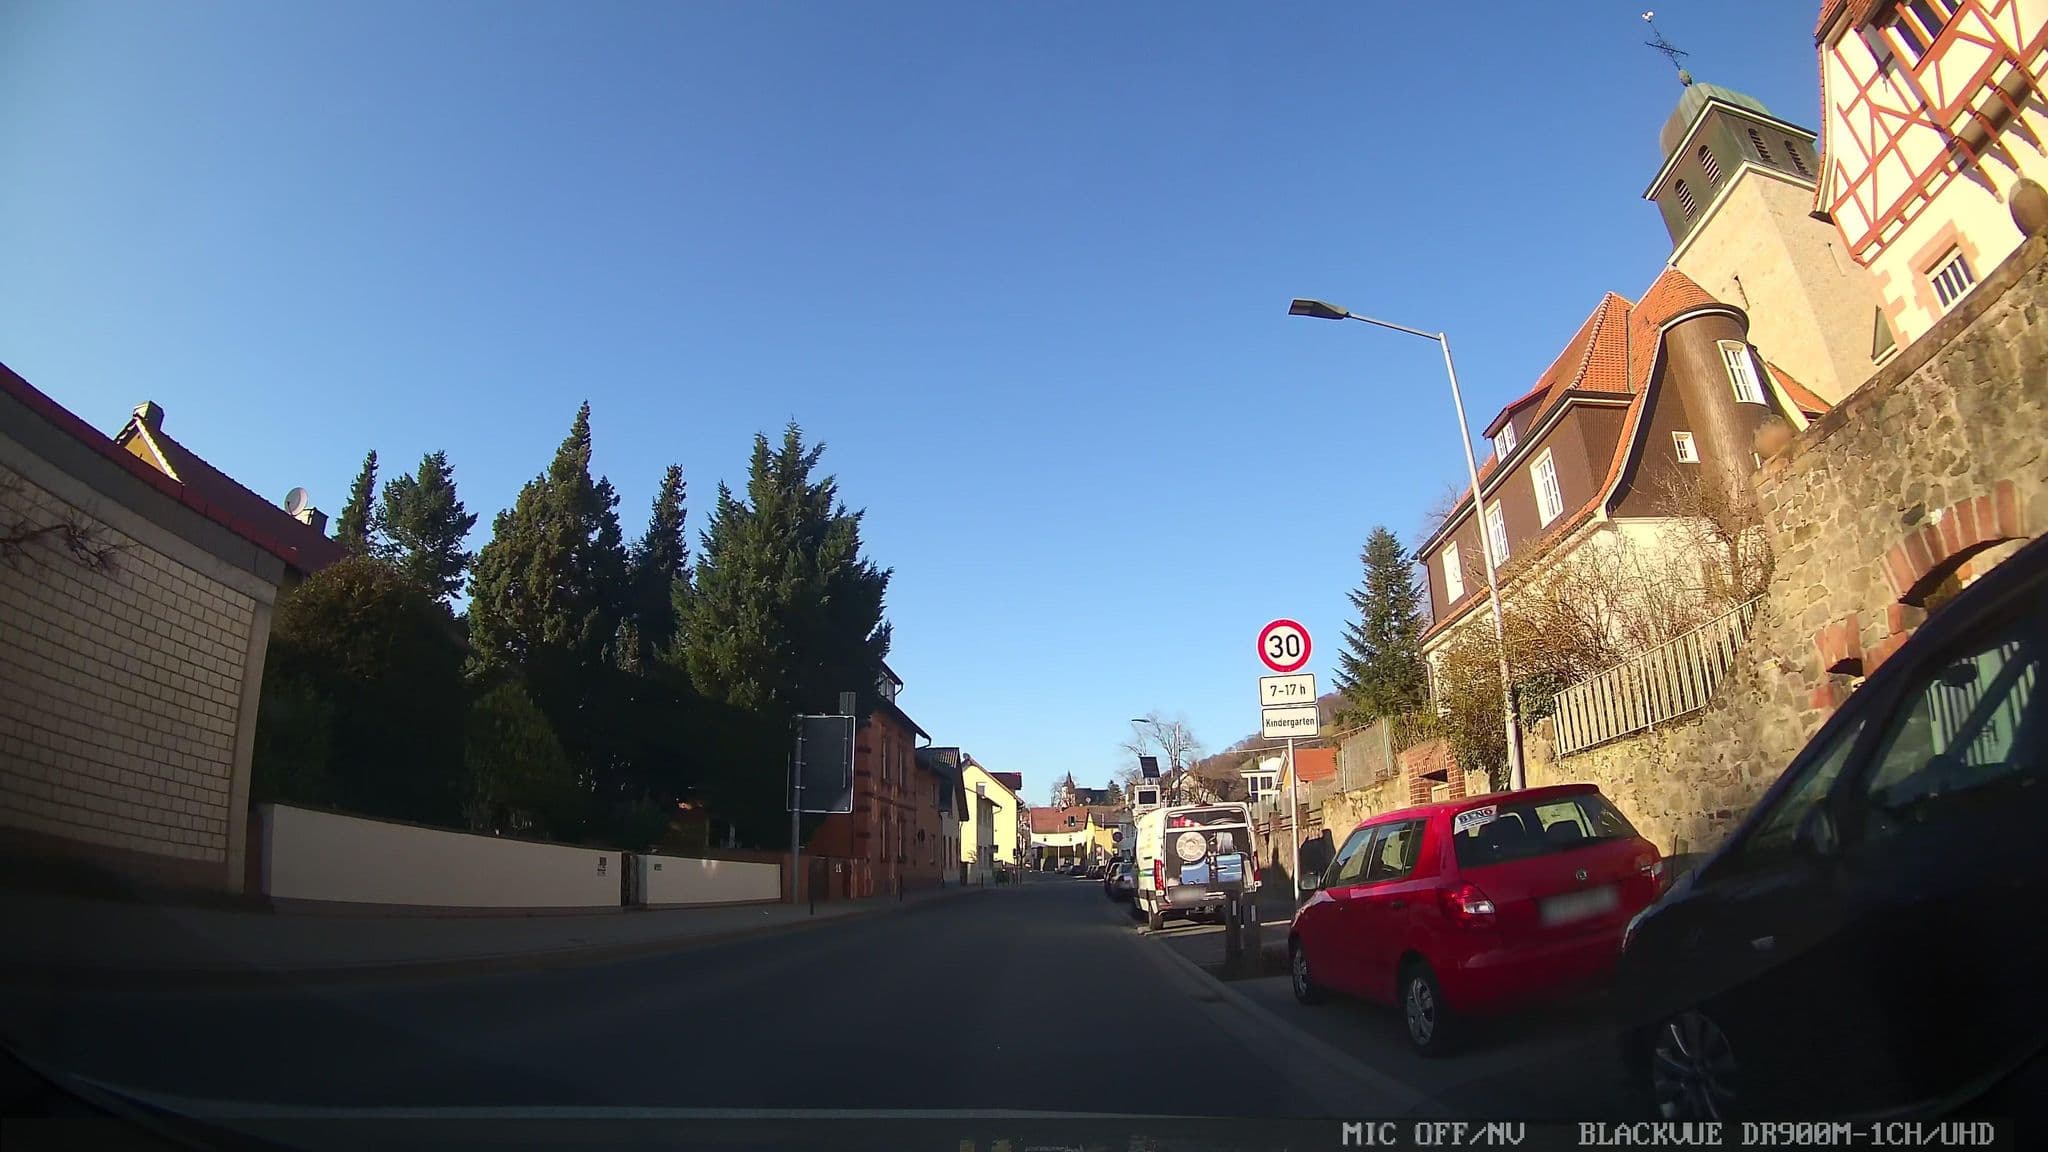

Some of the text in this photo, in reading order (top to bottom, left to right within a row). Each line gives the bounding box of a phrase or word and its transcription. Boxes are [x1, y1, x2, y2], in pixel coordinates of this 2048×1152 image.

[1269, 634, 1300, 658] 30
[1270, 684, 1306, 696] 7-17 h
[1265, 717, 1315, 728] Kindergarten
